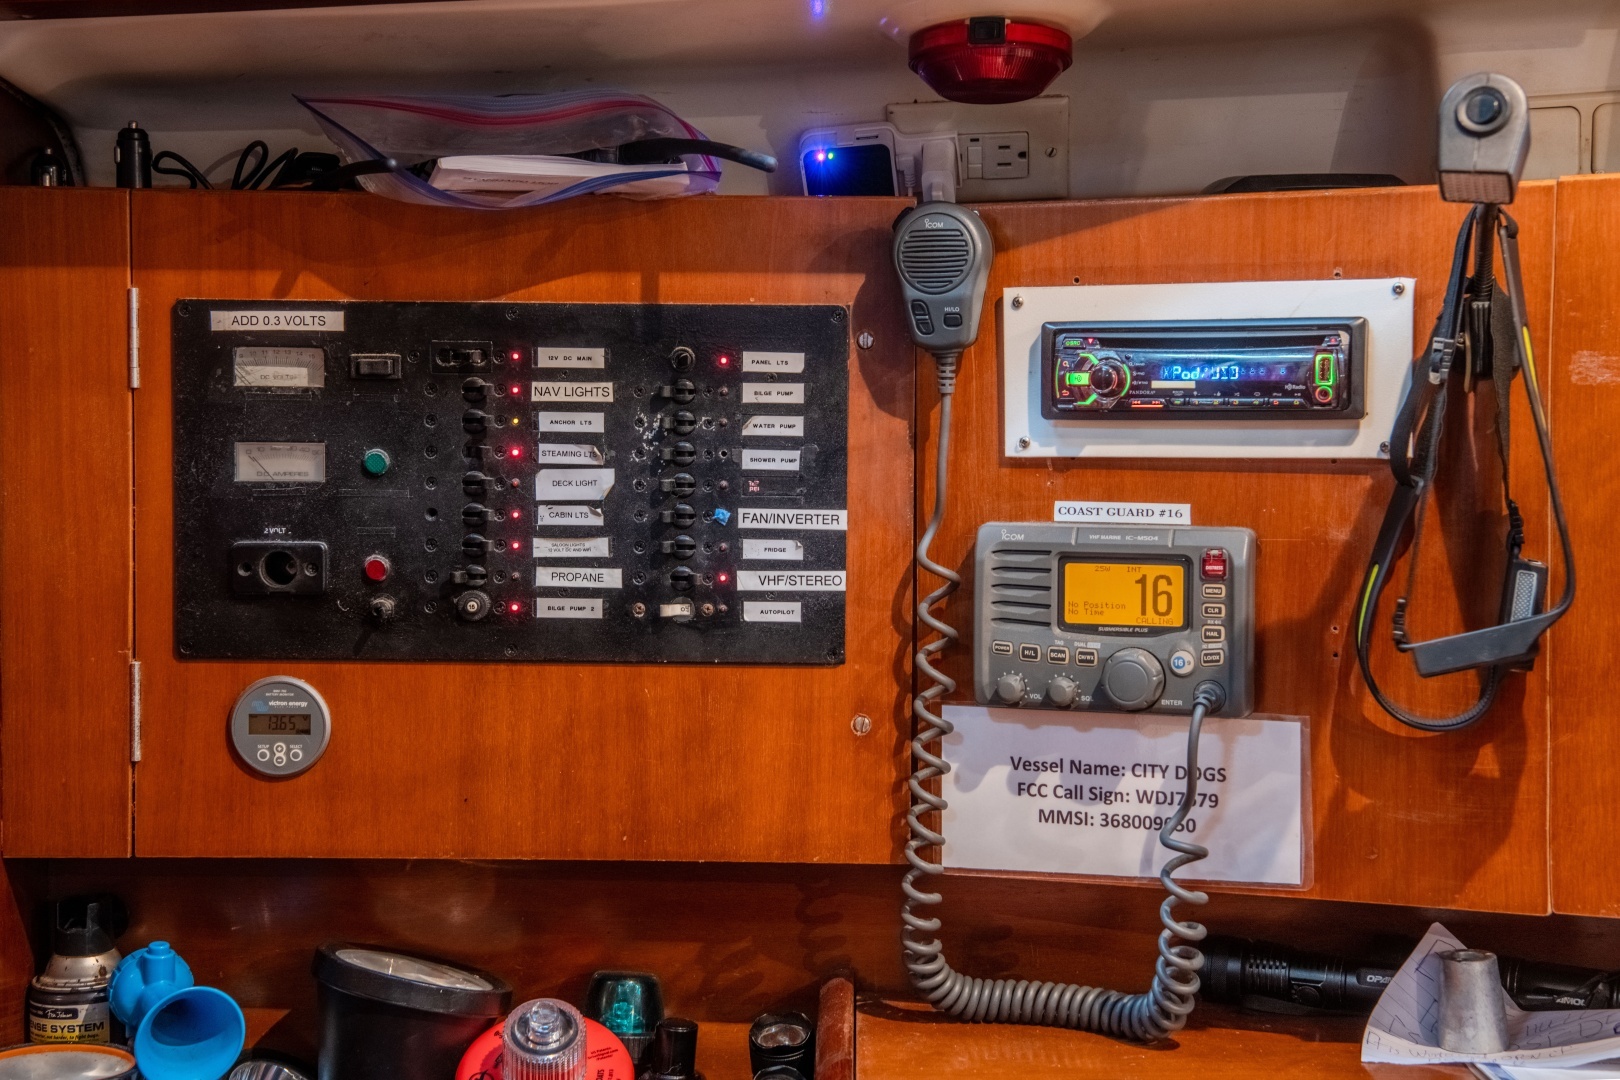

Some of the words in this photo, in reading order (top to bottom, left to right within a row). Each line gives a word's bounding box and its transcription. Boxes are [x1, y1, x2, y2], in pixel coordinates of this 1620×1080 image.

[231, 316, 259, 326] ADD
[263, 316, 280, 326] 0.3
[284, 316, 326, 326] VOLTS
[534, 386, 561, 397] NAV
[564, 386, 610, 397] LIGHTS
[541, 450, 582, 458] STEAMING
[1058, 506, 1102, 516] COAST
[1106, 507, 1155, 517] GUARD
[1159, 508, 1183, 518] #16
[742, 513, 840, 525] FAN/INVERTER
[551, 572, 604, 582] PROPANE
[758, 575, 843, 586] VHF/STEREO
[1134, 573, 1173, 617] 16
[1083, 601, 1126, 609] Position
[1136, 617, 1173, 625] CALLING
[268, 715, 296, 731] 13.65
[1010, 756, 1063, 774] Vessel
[1070, 760, 1126, 777] Name:
[1131, 763, 1170, 778] CITY
[1175, 765, 1227, 783] DGS
[1017, 782, 1048, 798] FCC
[1053, 785, 1083, 800] Call
[1088, 788, 1130, 805] Sign:
[1136, 789, 1219, 808] WDJ779
[1038, 809, 1094, 826] MMSI:
[50, 1021, 104, 1034] SYSTEM
